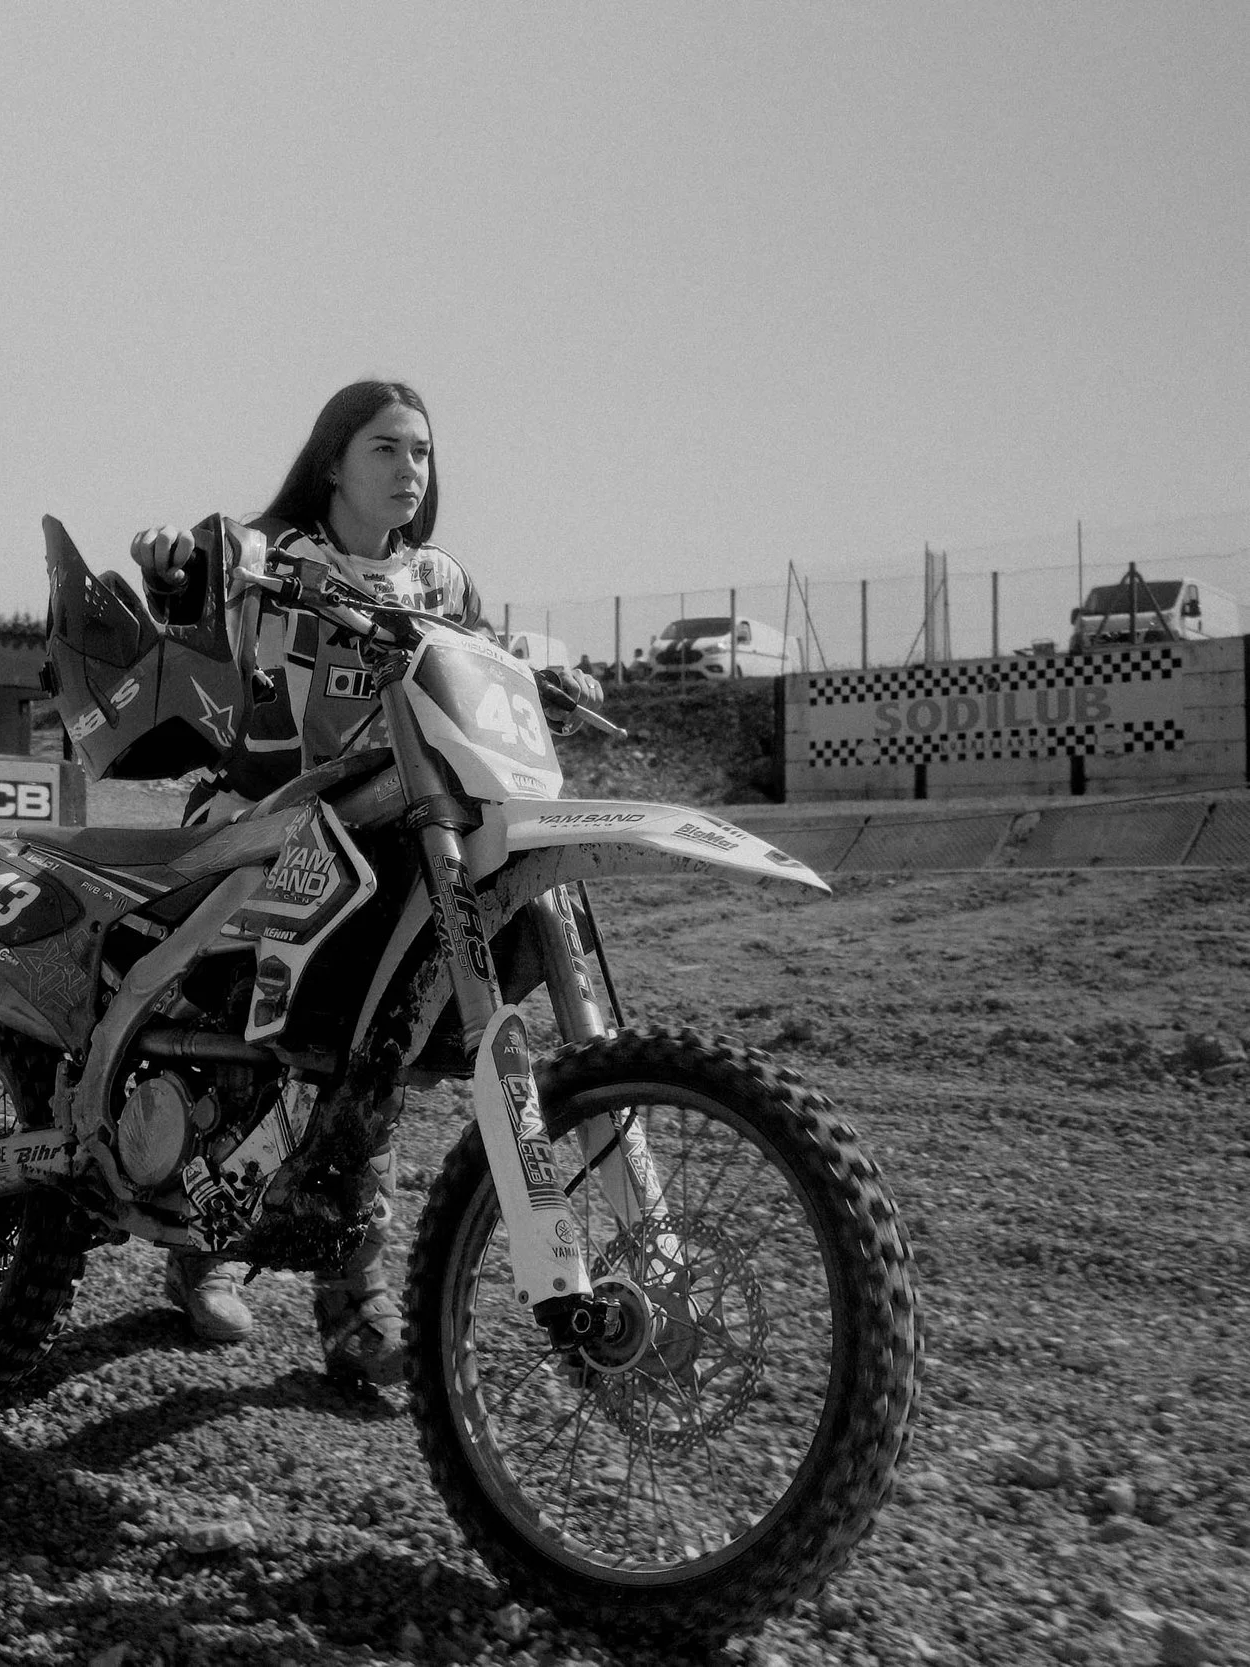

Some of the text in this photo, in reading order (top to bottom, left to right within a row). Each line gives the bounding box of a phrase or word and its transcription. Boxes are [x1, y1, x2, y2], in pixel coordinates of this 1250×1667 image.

[476, 683, 546, 757] 43
[875, 687, 1113, 737] SODILUB
[283, 846, 336, 873] YAM
[266, 868, 327, 897] SAND
[263, 926, 297, 941] KENNY
[14, 1145, 63, 1164] Bihr
[523, 1144, 541, 1184] CLUB
